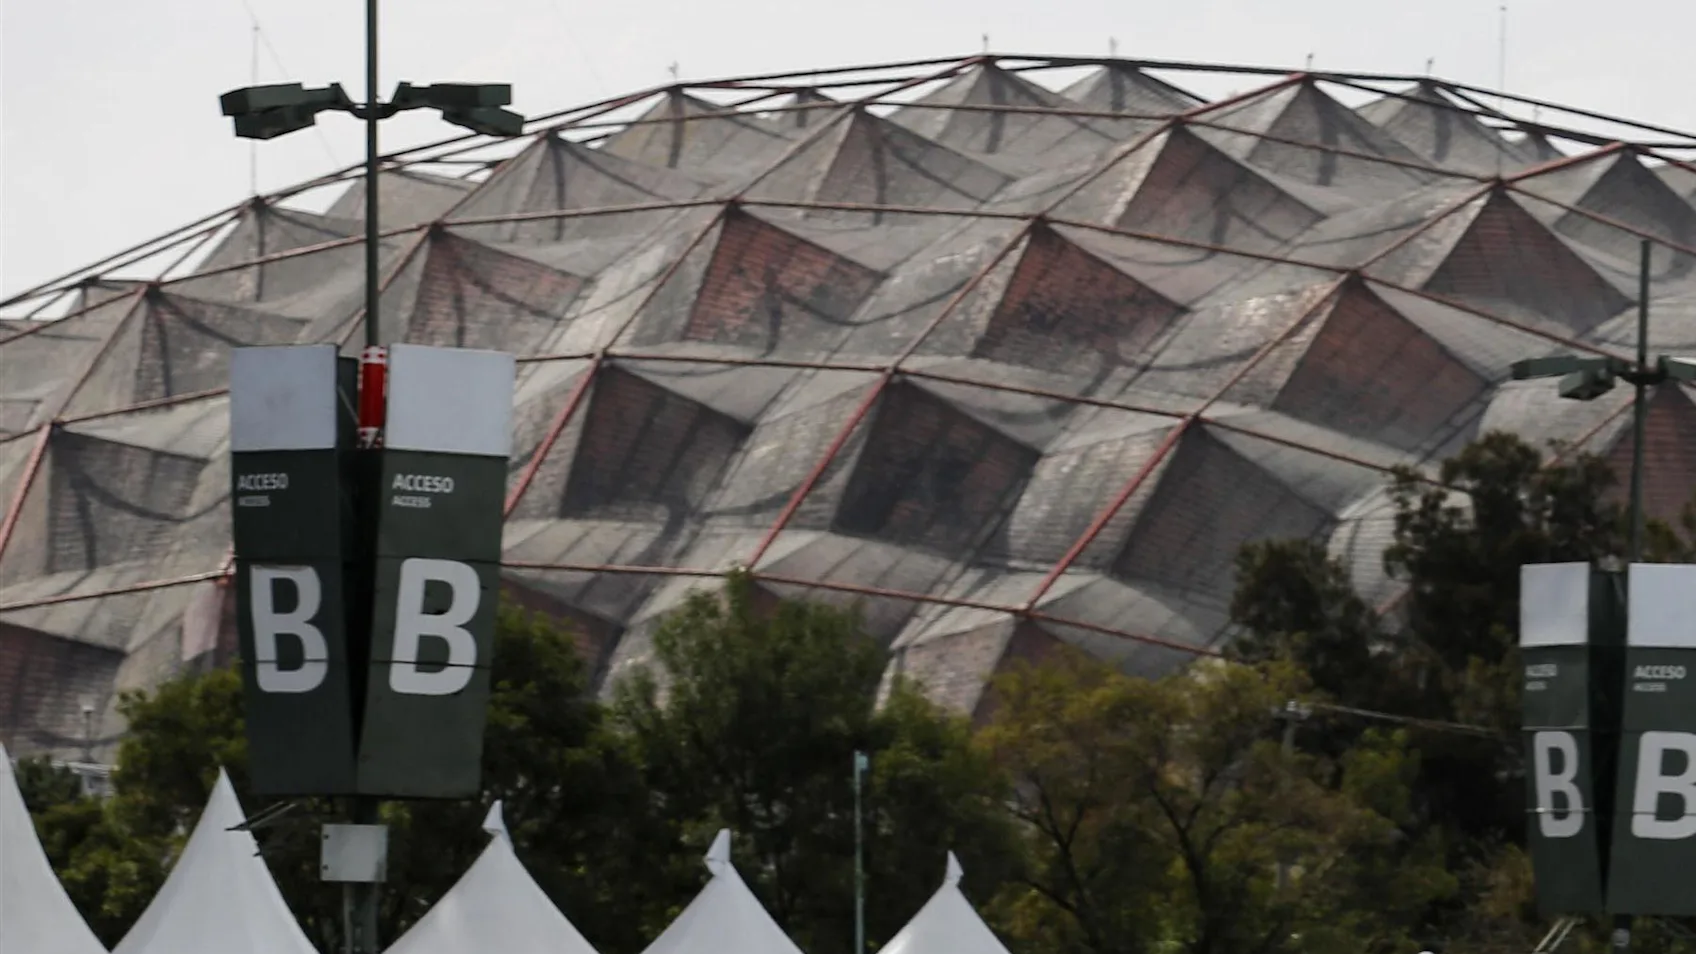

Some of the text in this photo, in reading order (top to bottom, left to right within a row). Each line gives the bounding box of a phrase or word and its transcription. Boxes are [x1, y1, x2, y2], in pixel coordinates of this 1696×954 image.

[237, 473, 288, 490] ACCESO
[392, 473, 454, 493] ACCESO
[249, 564, 329, 693] B
[388, 557, 481, 696] B
[1633, 665, 1686, 679] ACCESO
[1533, 730, 1585, 838] B
